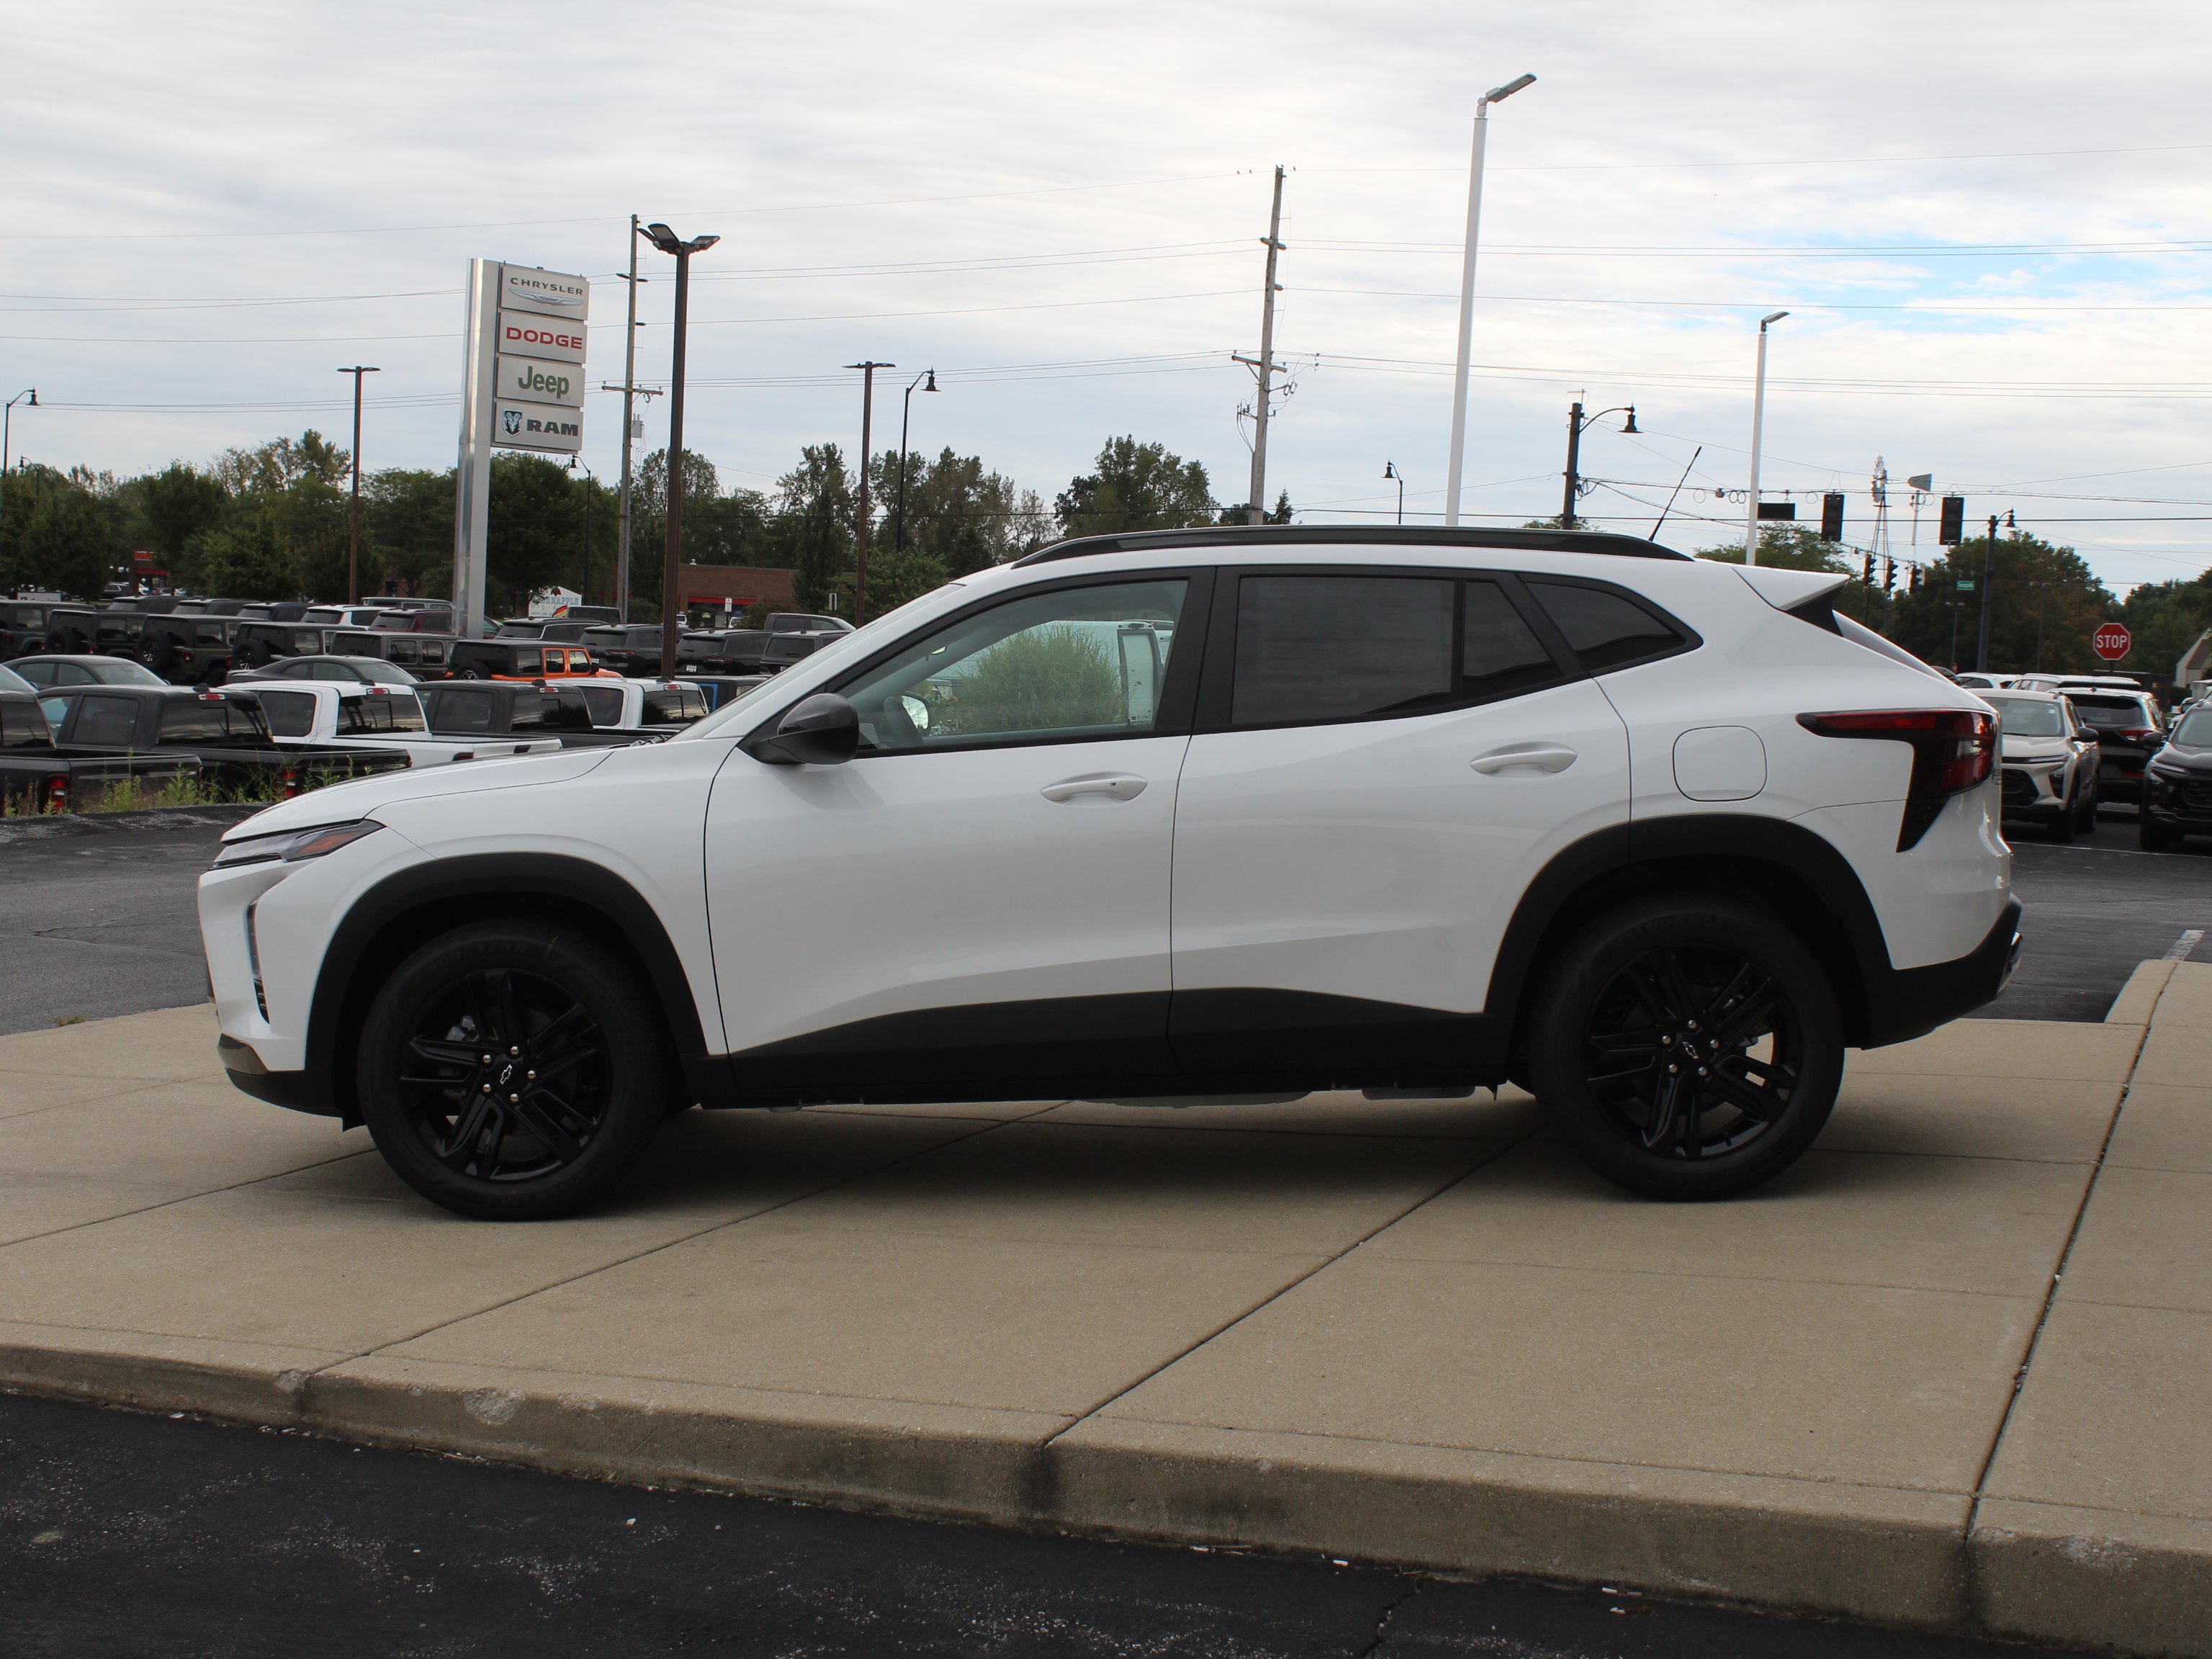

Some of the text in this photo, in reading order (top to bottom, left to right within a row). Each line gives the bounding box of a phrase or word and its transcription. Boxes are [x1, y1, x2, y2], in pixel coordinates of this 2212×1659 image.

[511, 277, 583, 295] CHRYSLER
[506, 327, 583, 349] DODGE
[518, 366, 569, 398] Jeep
[526, 419, 577, 436] RAM
[2096, 635, 2127, 648] STOP
